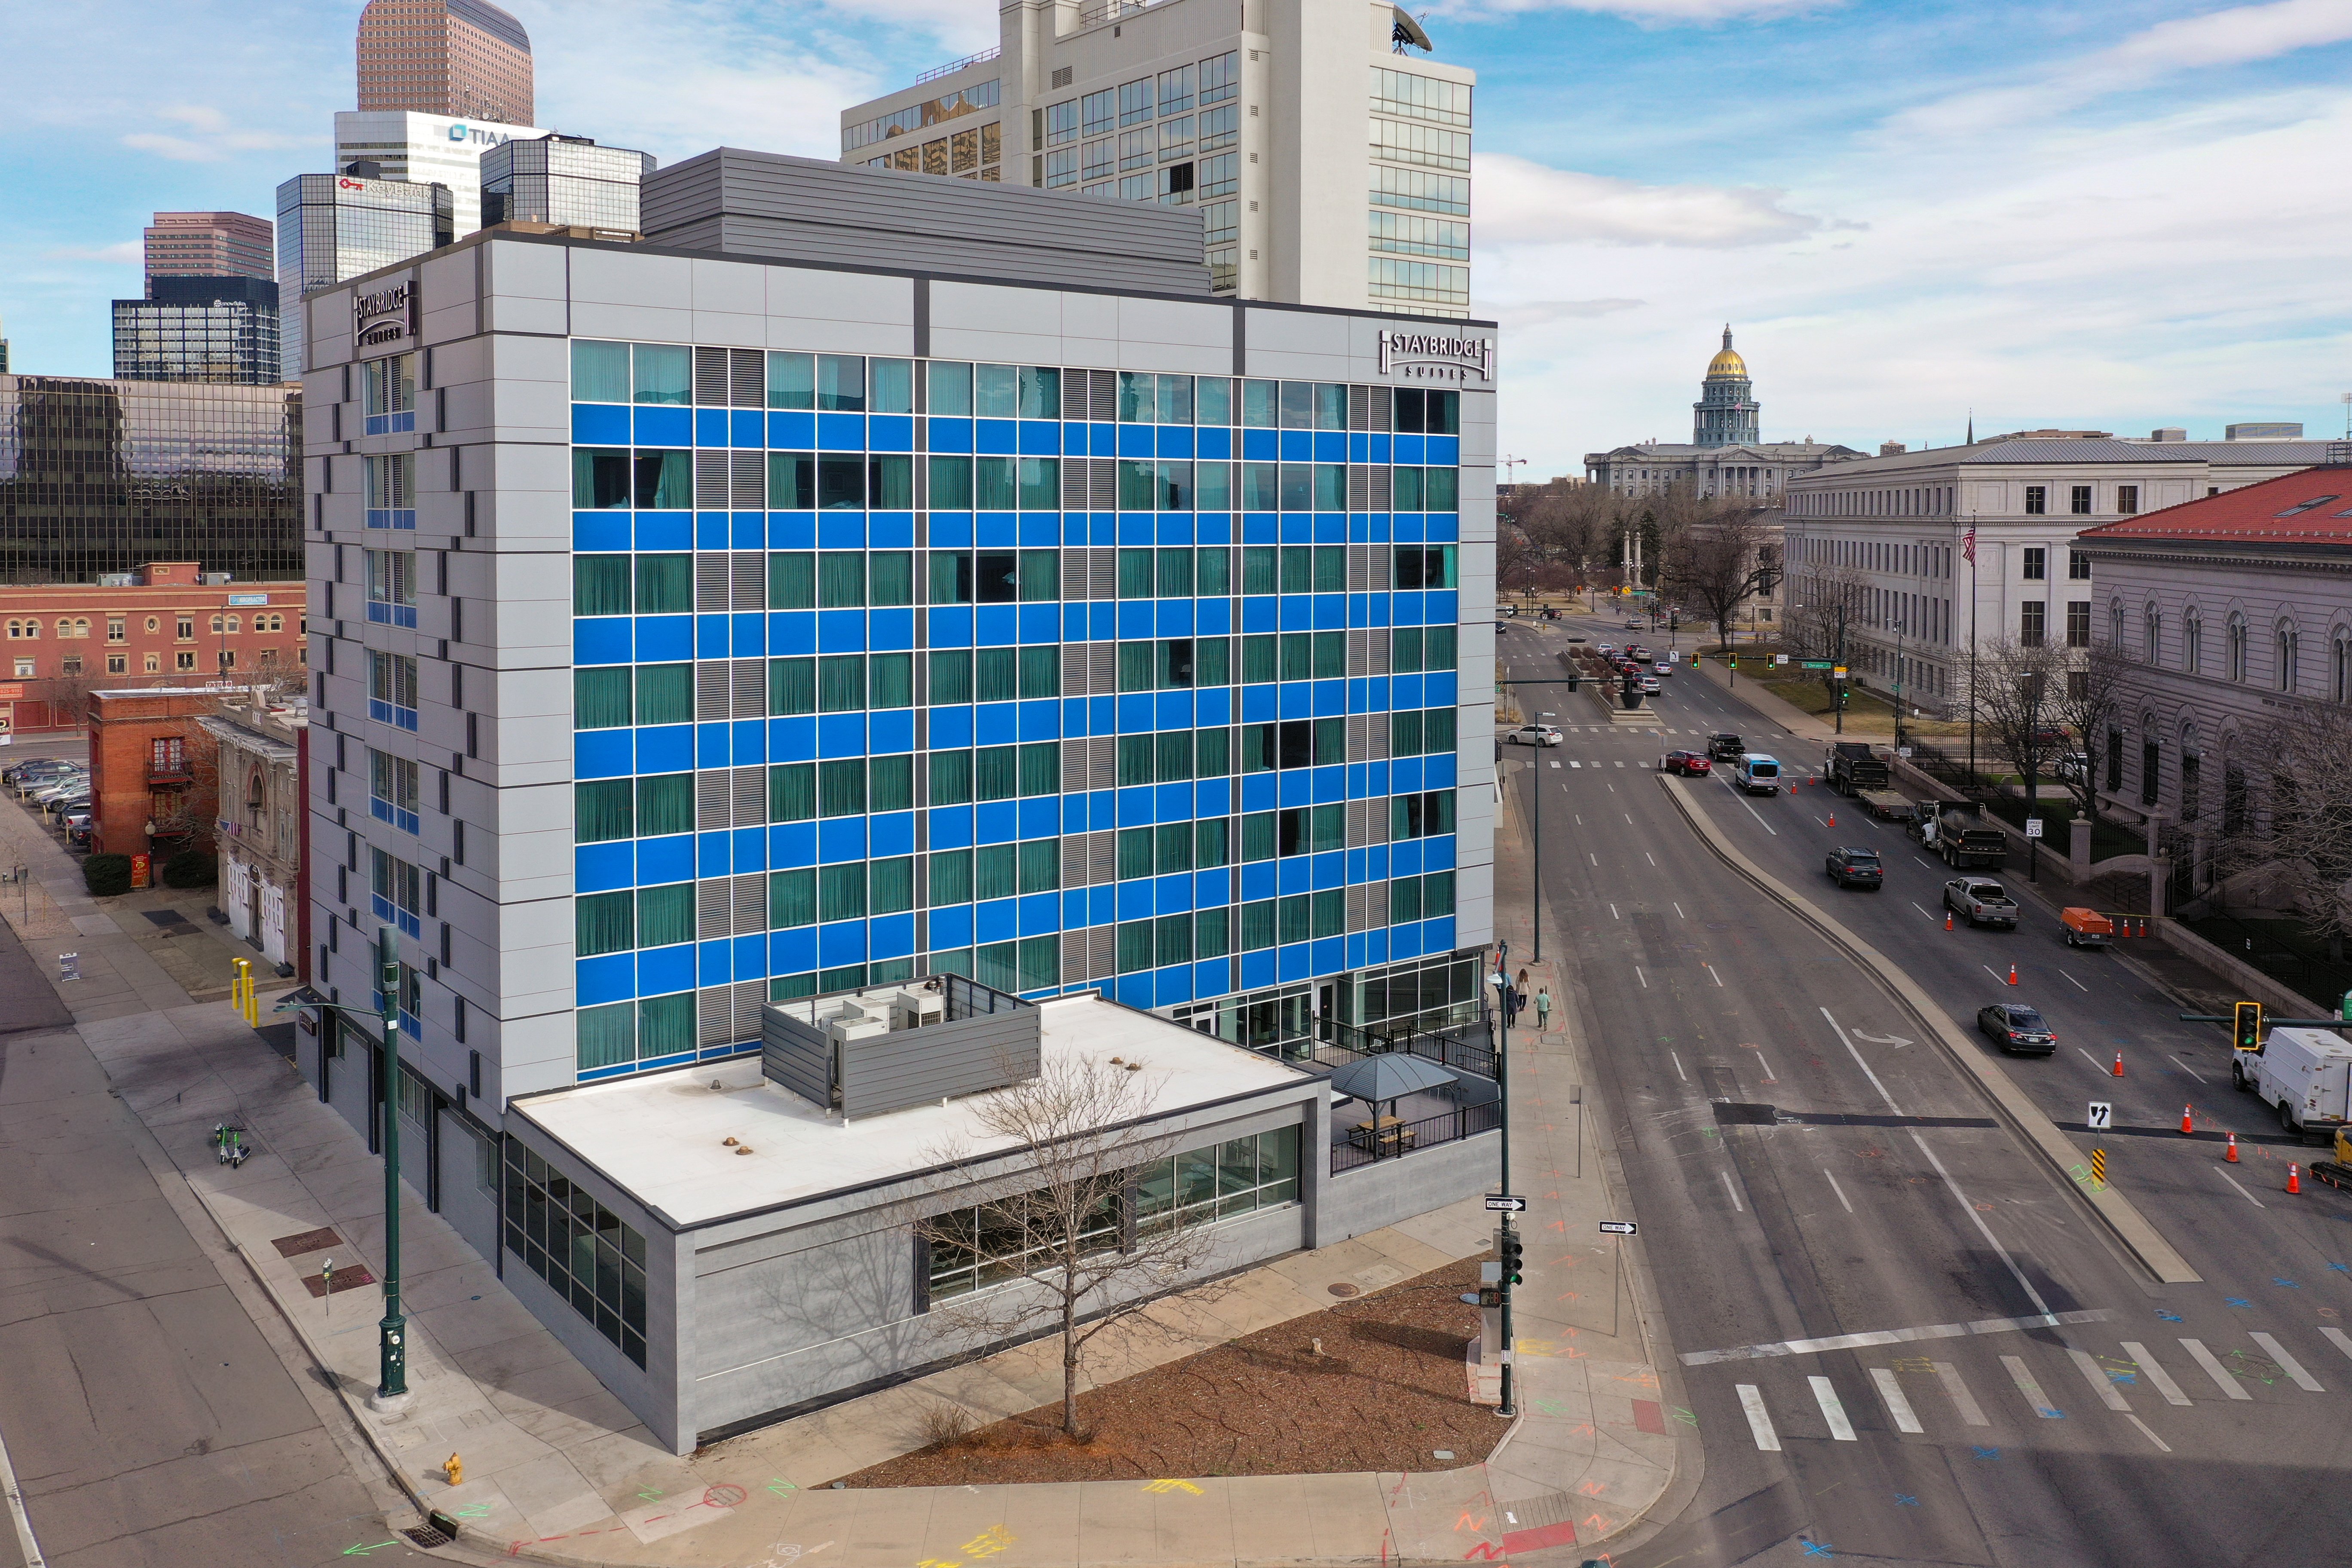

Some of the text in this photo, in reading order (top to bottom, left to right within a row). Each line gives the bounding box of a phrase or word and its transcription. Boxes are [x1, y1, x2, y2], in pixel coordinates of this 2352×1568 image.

[367, 181, 431, 198] KeyBank
[358, 286, 403, 318] STAYBRIDGE
[366, 327, 398, 345] SUITES
[1393, 334, 1482, 357] STAYBRIDGE
[1407, 366, 1468, 379] SUITES
